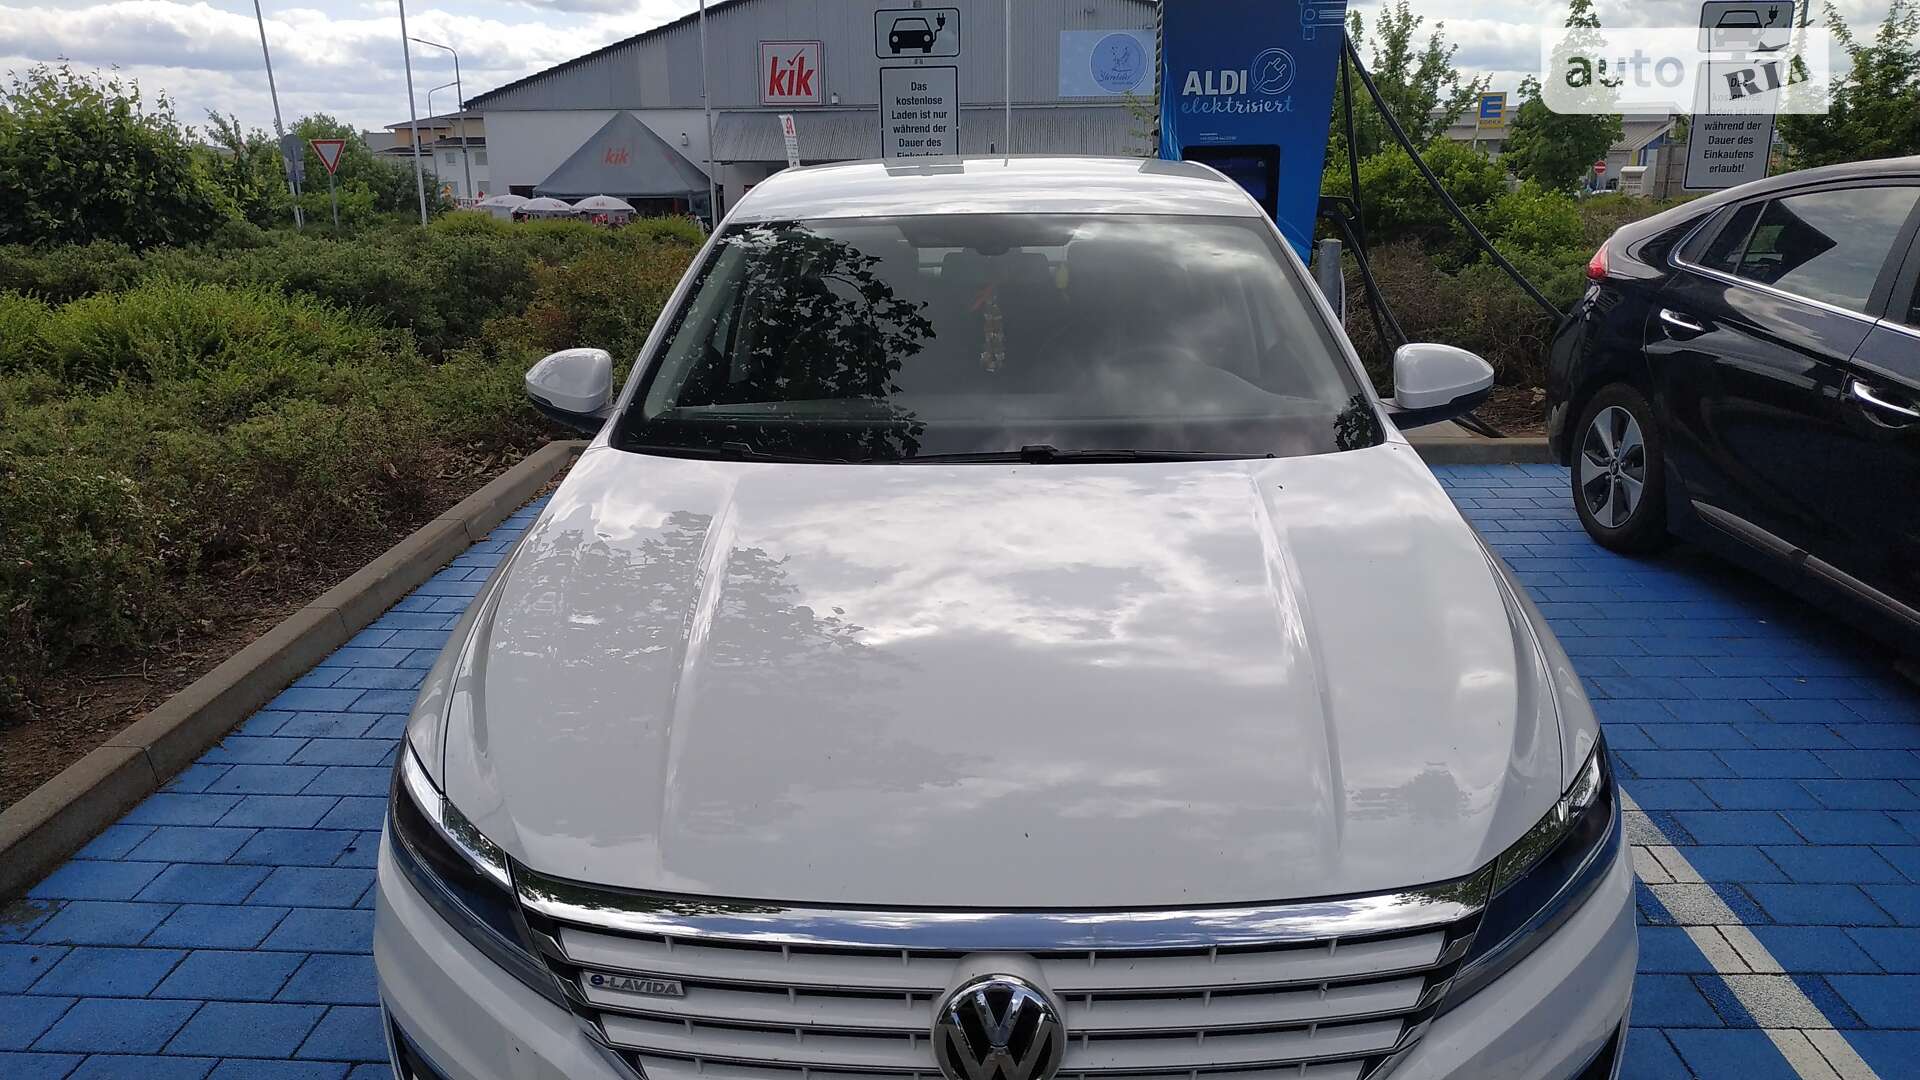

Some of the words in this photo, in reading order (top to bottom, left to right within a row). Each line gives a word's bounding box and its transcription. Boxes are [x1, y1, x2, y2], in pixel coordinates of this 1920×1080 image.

[768, 48, 815, 96] kik
[911, 81, 928, 91] Das
[1182, 70, 1247, 96] ALDI
[895, 96, 943, 106] kostenlose
[1181, 95, 1295, 114] elektrisiert
[891, 110, 918, 120] Laden
[920, 110, 931, 119] ist
[933, 111, 947, 119] nur
[893, 124, 931, 134] während
[933, 123, 947, 133] der
[1704, 121, 1745, 131] während
[1747, 121, 1762, 131] der
[898, 138, 924, 148] Dauer
[926, 137, 942, 147] des
[1708, 135, 1736, 145] Dauer
[1737, 135, 1754, 145] des
[1703, 149, 1755, 159] Einkaufens
[1709, 163, 1745, 173] erlaubt!
